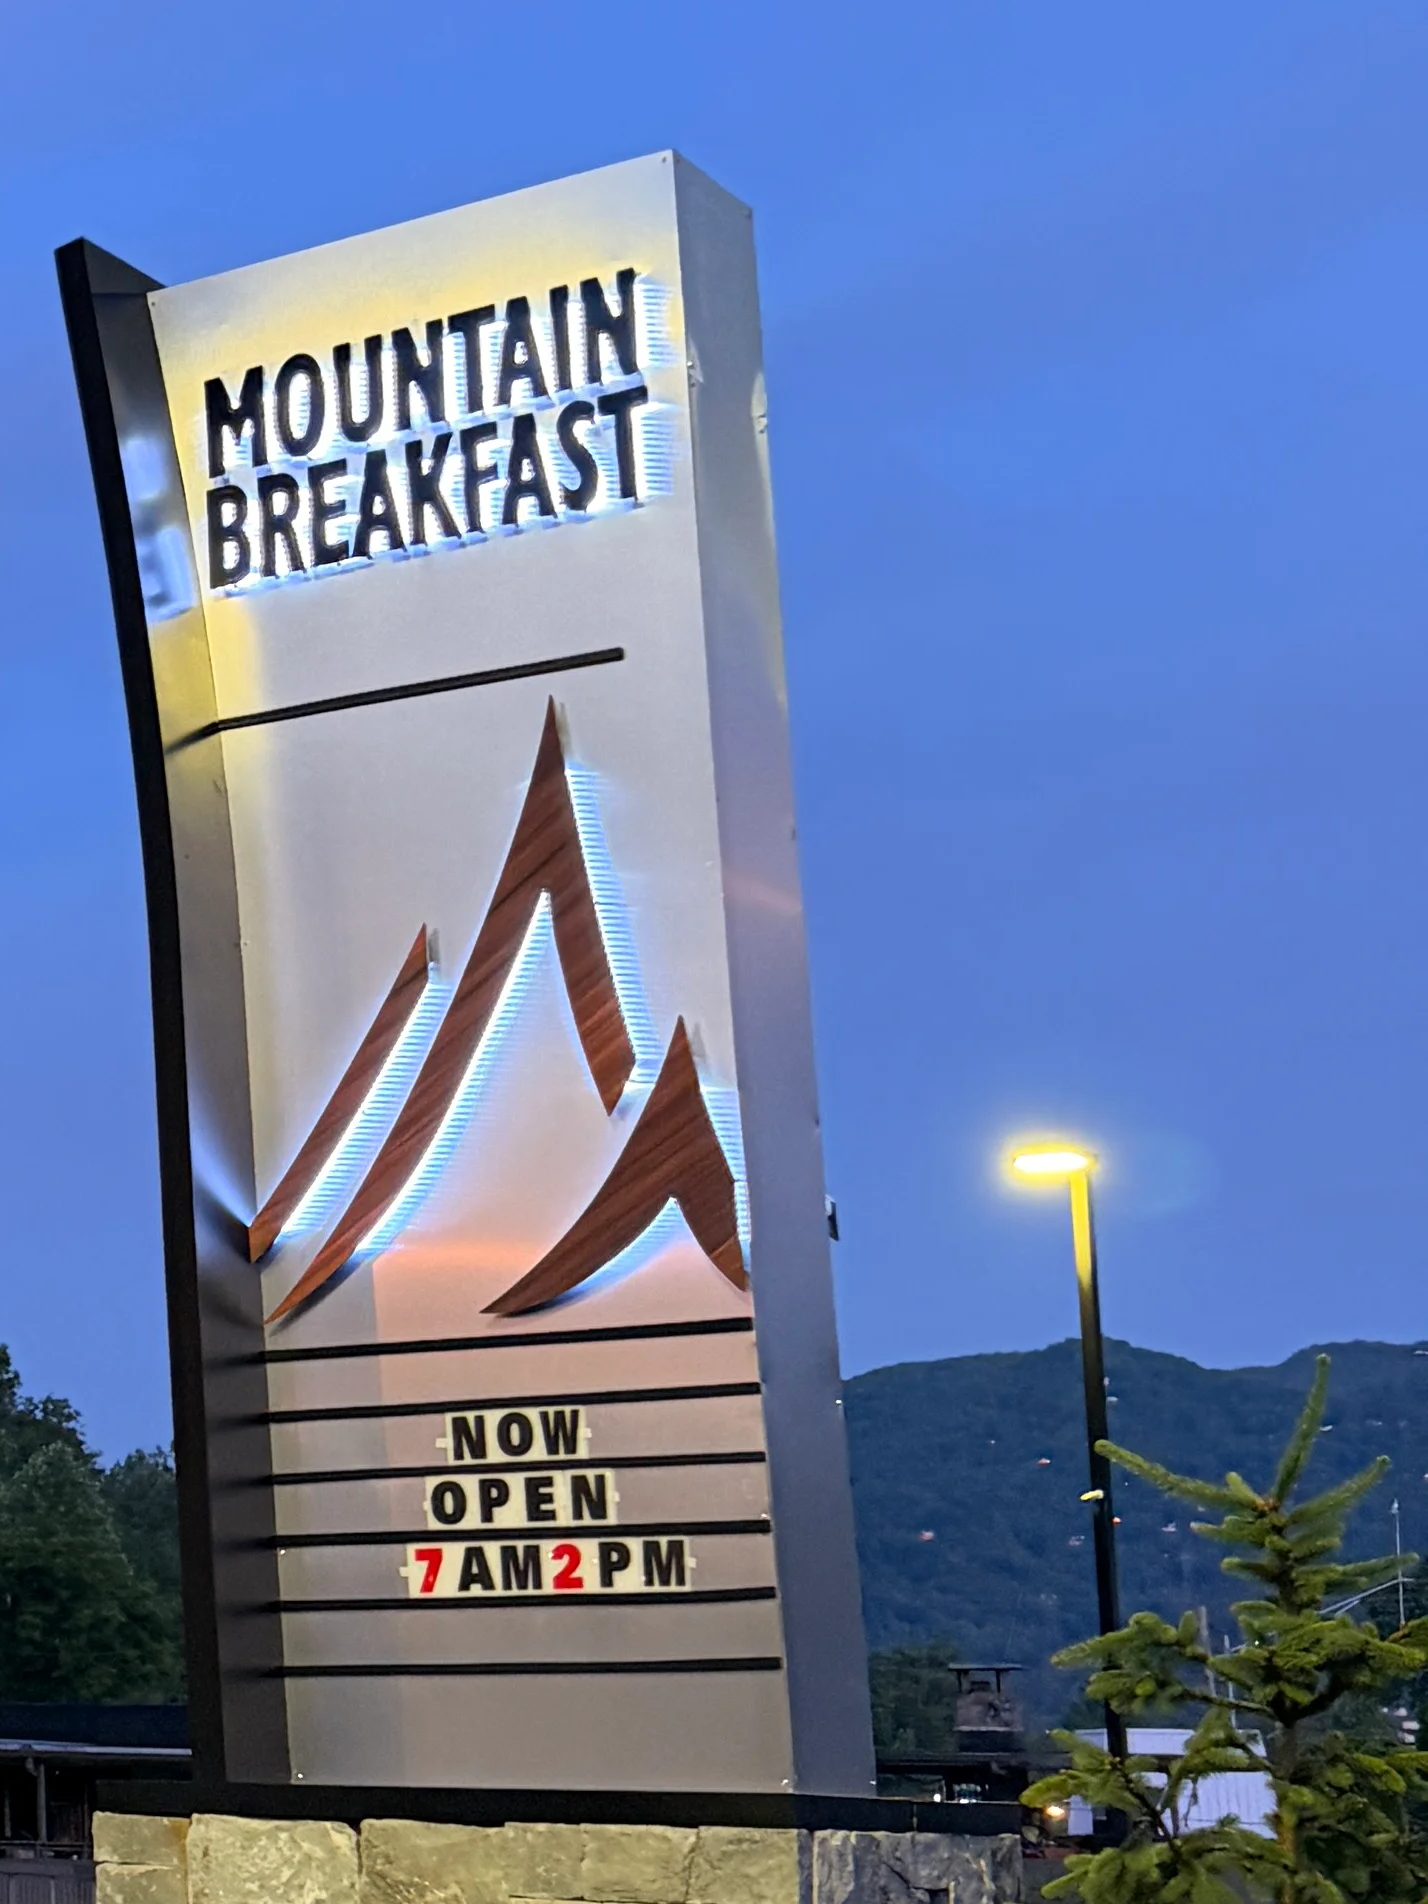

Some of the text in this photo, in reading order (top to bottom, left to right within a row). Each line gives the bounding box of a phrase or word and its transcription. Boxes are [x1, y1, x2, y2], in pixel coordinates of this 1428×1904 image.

[204, 267, 639, 479] MOUNTAIN
[206, 385, 648, 589] BREAKFAST
[451, 1408, 581, 1461] NOW
[430, 1474, 609, 1525] OPEN
